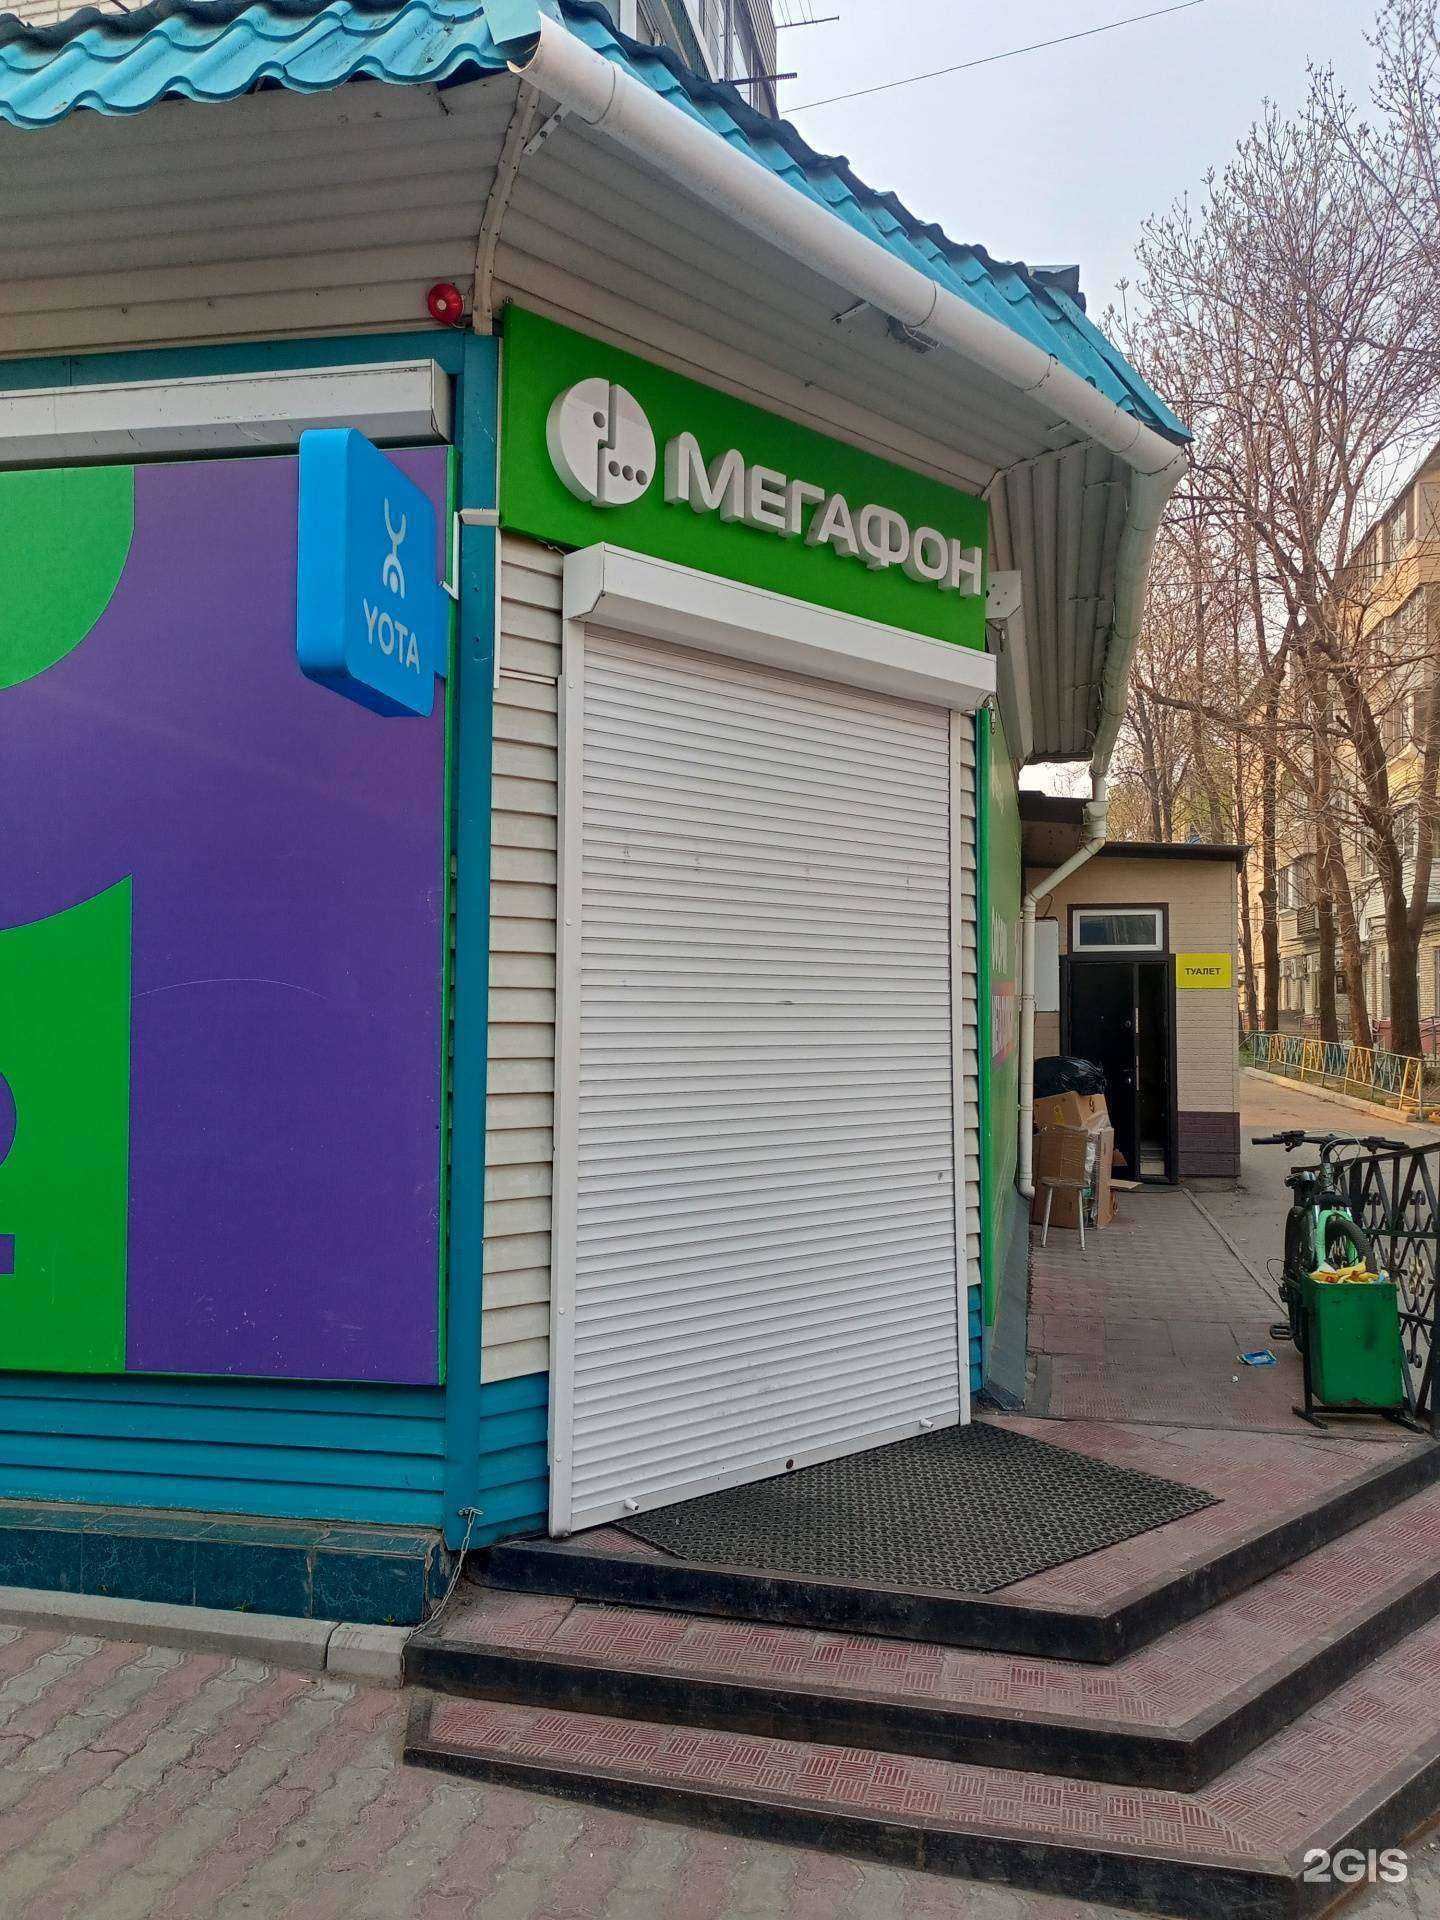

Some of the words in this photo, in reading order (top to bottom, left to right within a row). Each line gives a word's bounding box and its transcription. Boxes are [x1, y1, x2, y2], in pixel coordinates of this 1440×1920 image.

[664, 431, 982, 598] МЕГАФОН
[363, 598, 420, 674] YOTA
[1185, 967, 1221, 976] ТУАЛЕТ
